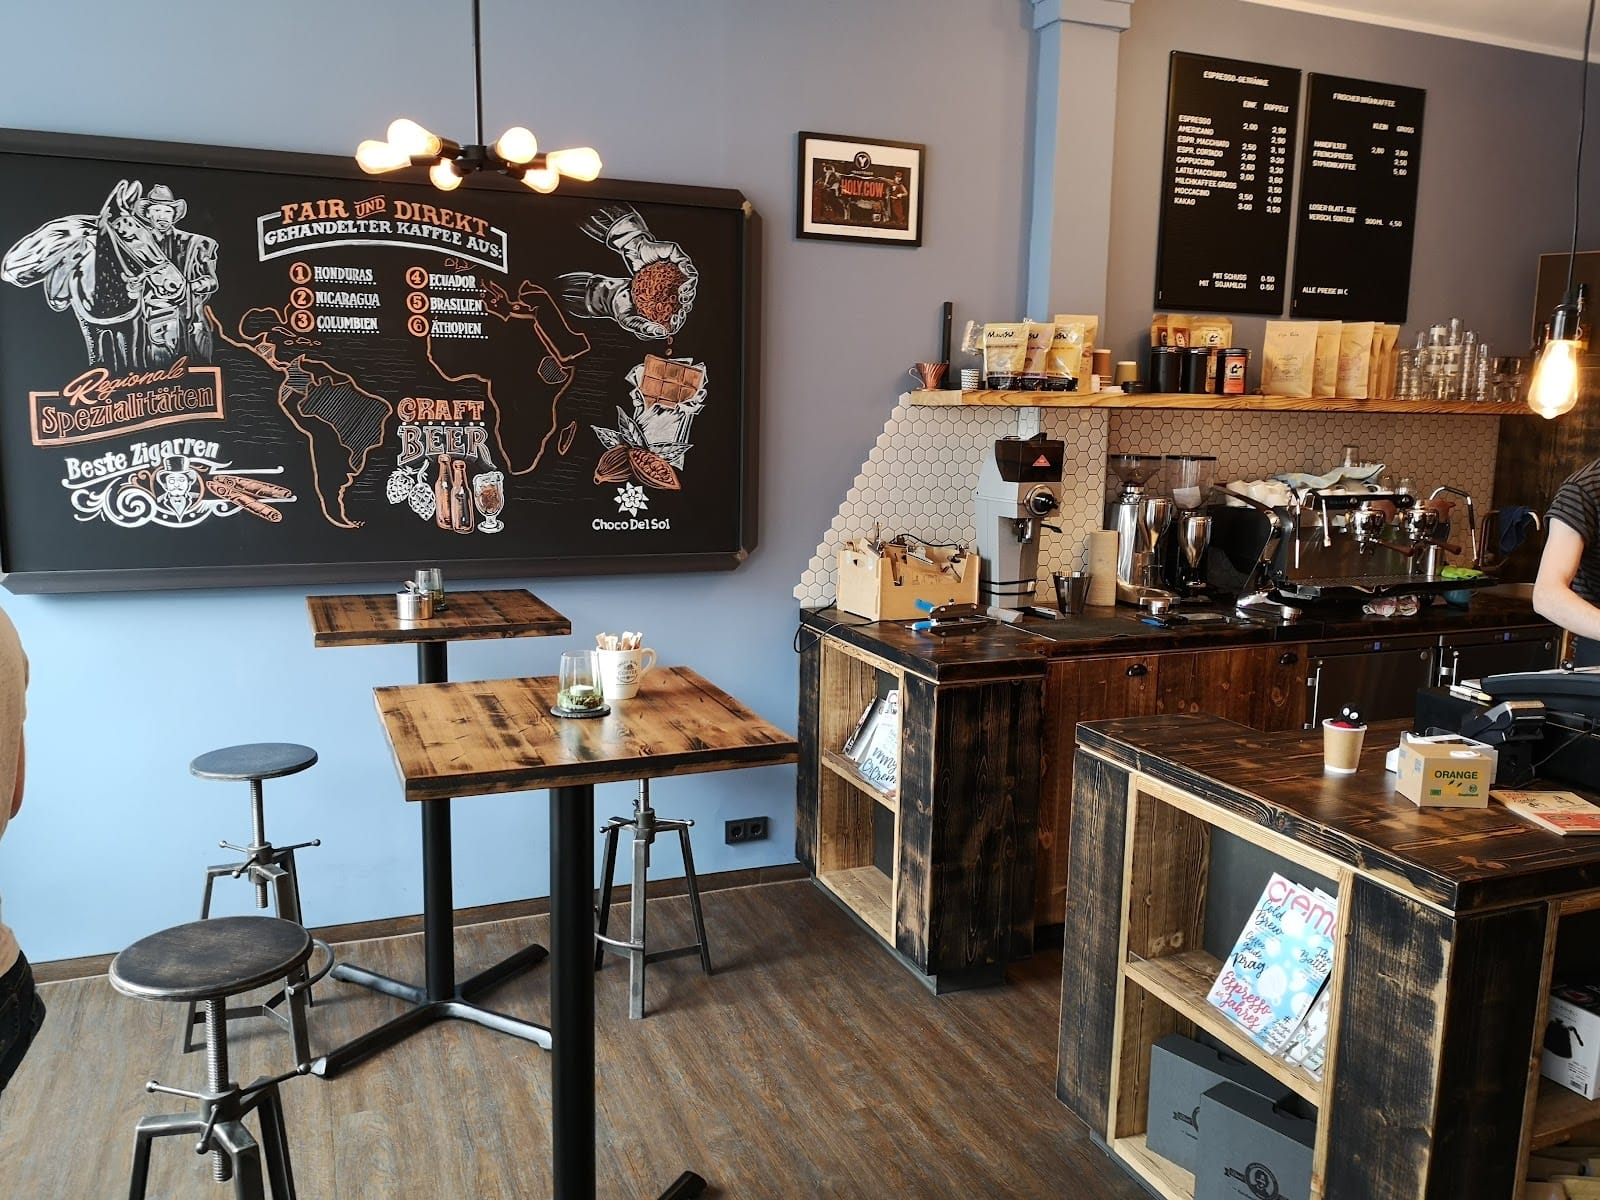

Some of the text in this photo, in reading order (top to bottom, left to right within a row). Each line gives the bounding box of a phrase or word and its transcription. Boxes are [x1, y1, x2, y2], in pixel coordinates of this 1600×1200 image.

[1178, 114, 1212, 125] ESPRESSO
[1178, 126, 1214, 136] AMERICANO
[1178, 136, 1196, 144] ESPR.
[1196, 138, 1230, 148] MACCHIATO
[1176, 146, 1196, 154] ESPR.
[1196, 148, 1224, 157] CORTADO
[1176, 156, 1215, 166] CAPPUCCINO
[1176, 166, 1194, 175] LATTE
[1194, 168, 1227, 178] MACCHIATO
[1174, 176, 1218, 188] MILCHKAFFEE
[1217, 181, 1238, 190] GROSS
[1174, 187, 1210, 196] MOCCACINO
[1174, 197, 1196, 206] KAKAO
[281, 198, 489, 237] FAIR UND DIREKT
[264, 220, 503, 258] GEHANDELTER KAFFEE AUS:
[295, 266, 374, 282] 1 HONDURAS
[410, 270, 476, 288] 4 ECUADOR
[1224, 273, 1248, 281] SCHUSS
[1214, 281, 1246, 289] SOJAMILCH
[297, 290, 381, 306] 2 NICARAGUA
[412, 296, 482, 311] 5 BRASILIEN
[298, 314, 378, 330] 3 COLUMBIEN
[412, 318, 482, 334] 6 ÄTHOPIEN
[64, 356, 188, 406] Regionale
[42, 386, 214, 438] Spezialitäten
[396, 397, 484, 422] CRAFT
[397, 425, 497, 470] BEER
[64, 438, 220, 480] Beste Zigarren
[592, 518, 671, 530] Choco Del Sol
[1434, 770, 1478, 780] ORANGE
[1260, 900, 1284, 922] Cold
[1255, 909, 1284, 936] Brew
[1222, 970, 1272, 1014] Espresso
[1220, 992, 1260, 1030] Jahres
